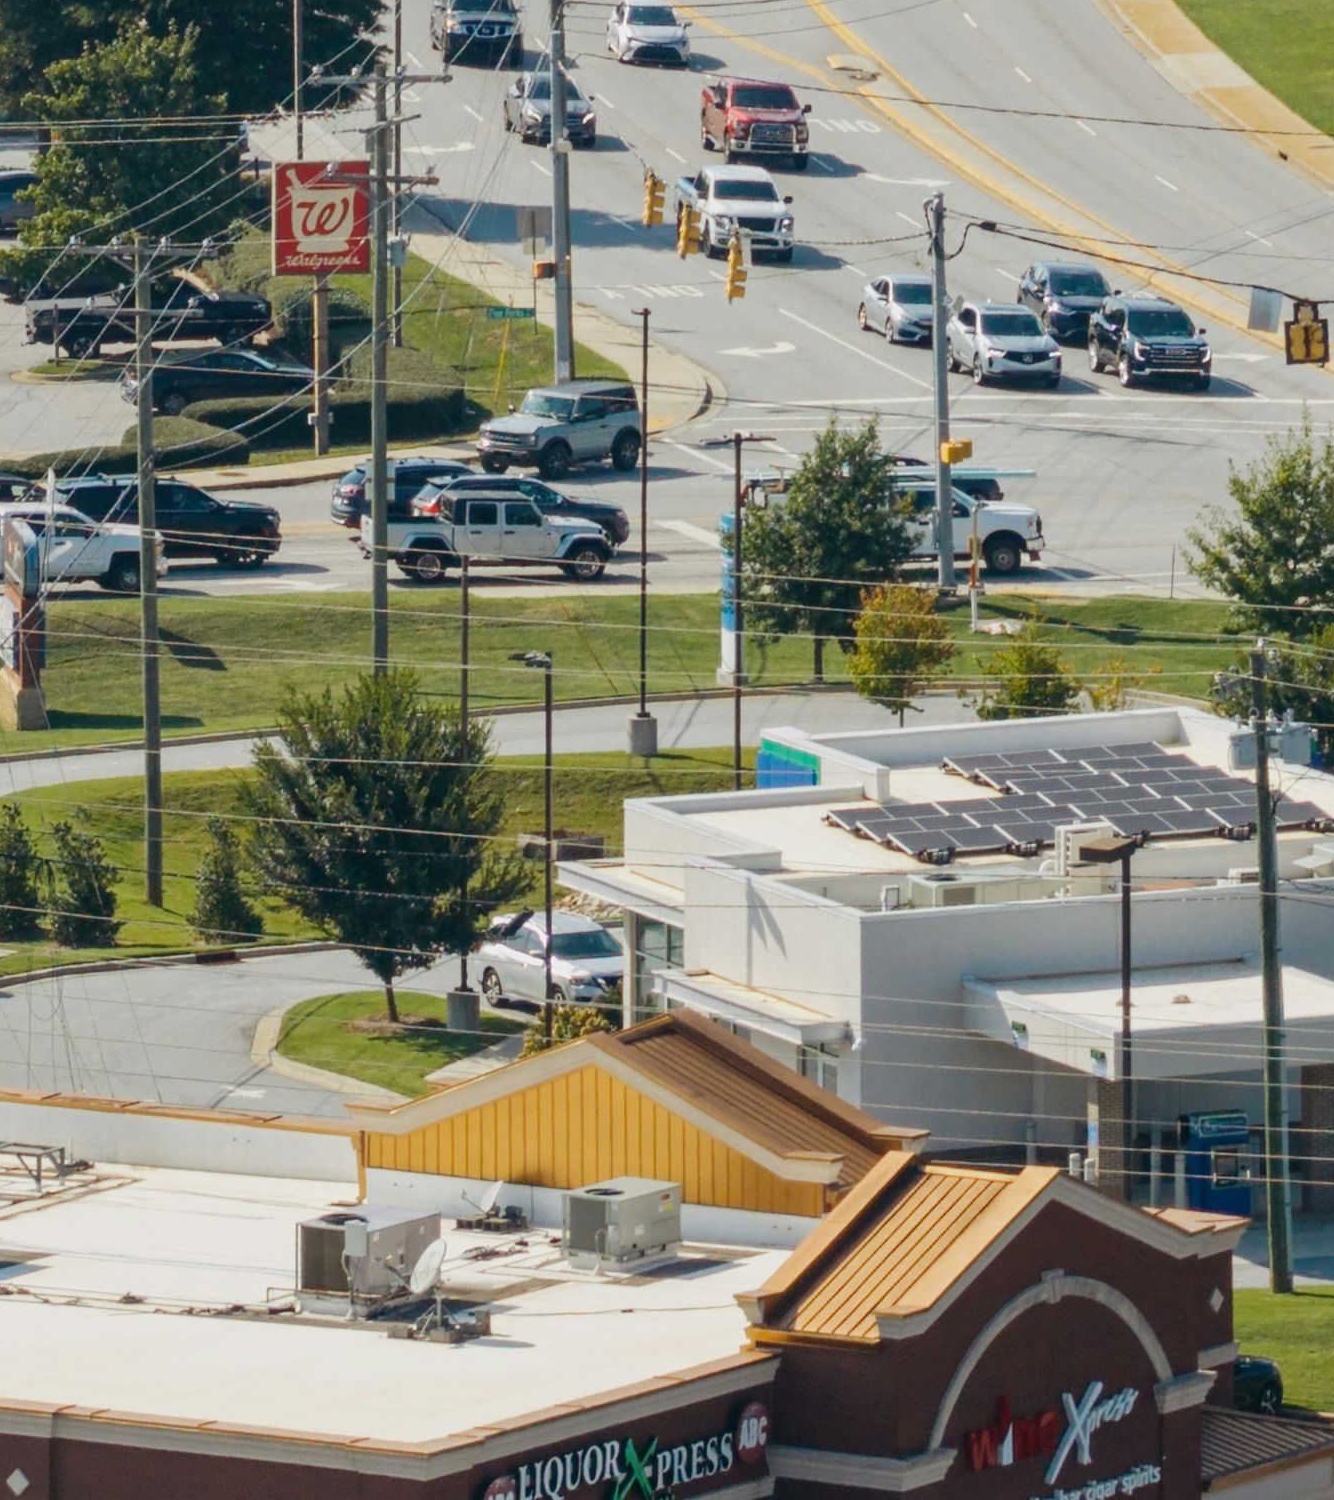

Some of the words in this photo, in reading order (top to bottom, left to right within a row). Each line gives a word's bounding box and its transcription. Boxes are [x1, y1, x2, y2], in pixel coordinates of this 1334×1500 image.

[285, 252, 361, 270] Walgreens
[739, 1415, 767, 1451] ABC
[518, 1440, 627, 1500] LIQUOR
[1121, 1464, 1162, 1496] spirits
